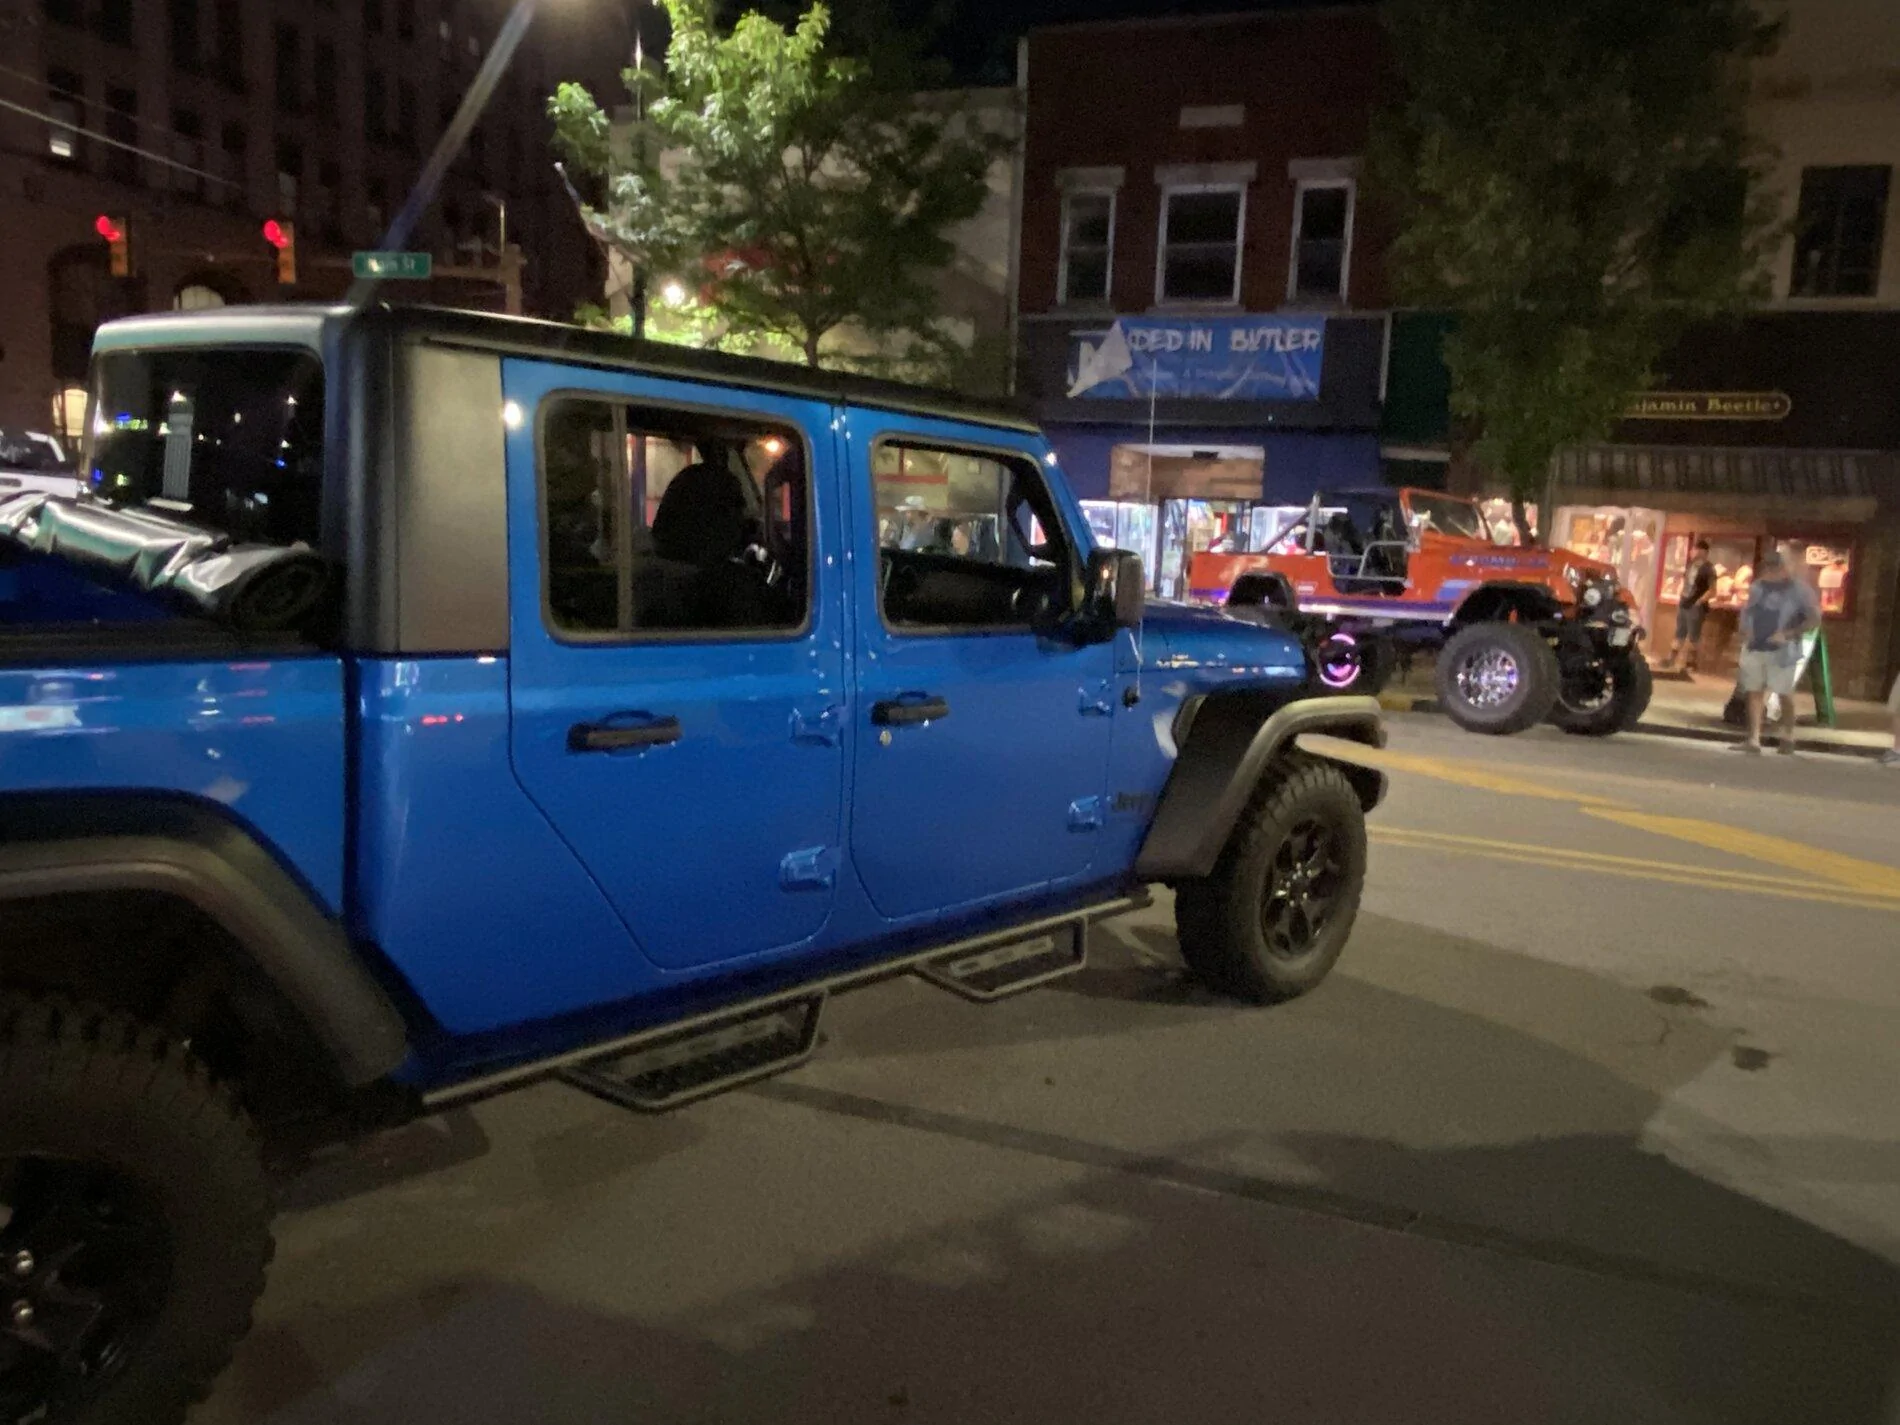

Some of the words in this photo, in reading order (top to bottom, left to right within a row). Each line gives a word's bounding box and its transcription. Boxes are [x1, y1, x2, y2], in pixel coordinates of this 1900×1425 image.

[1127, 327, 1183, 352] DED
[1190, 328, 1213, 352] IN
[1230, 327, 1321, 352] BUTLER
